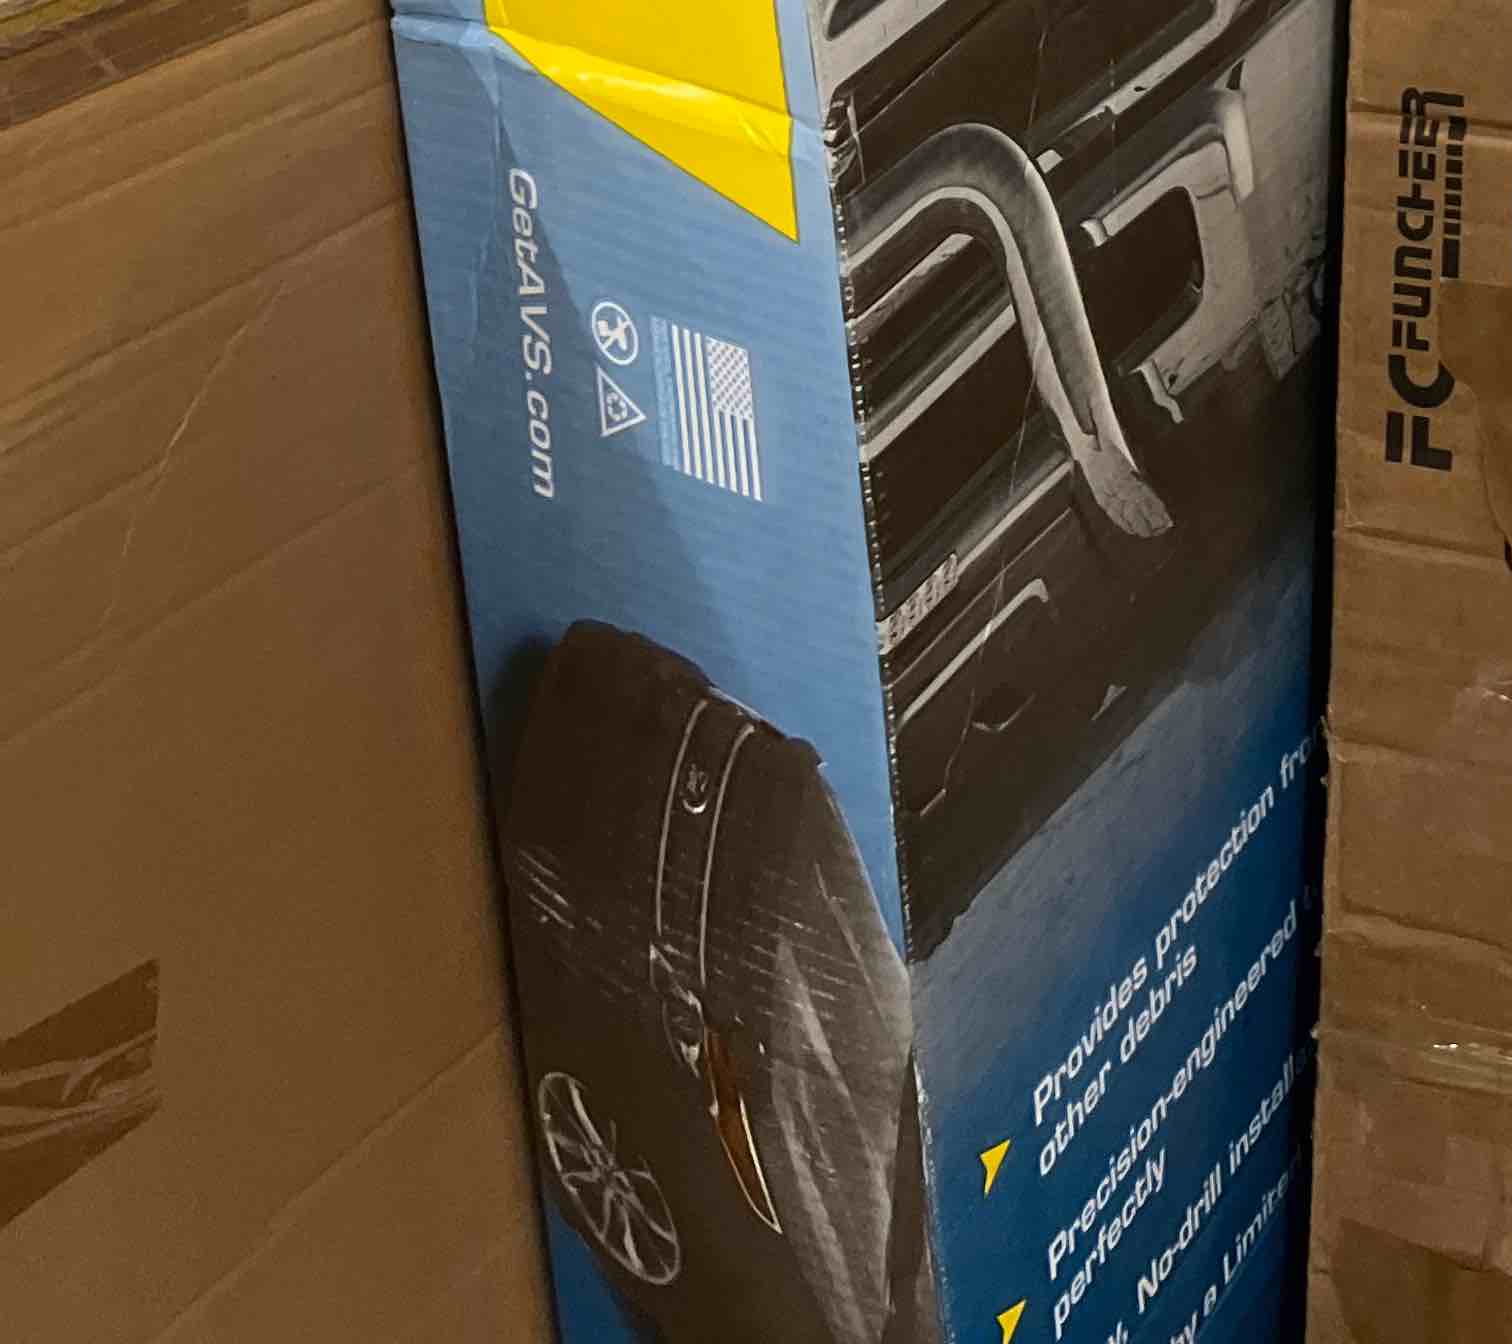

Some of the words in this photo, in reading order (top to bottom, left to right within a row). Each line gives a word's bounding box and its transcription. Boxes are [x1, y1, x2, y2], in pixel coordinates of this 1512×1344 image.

[509, 168, 554, 498] GetAVS.com
[1385, 353, 1456, 472] FC
[1032, 957, 1148, 1124] Provides
[1155, 786, 1275, 964] protection
[1039, 1060, 1112, 1177] other
[1120, 944, 1198, 1064] debris
[1047, 901, 1298, 1280] Precision-engineered
[1054, 1147, 1168, 1340] perfectly
[1137, 1162, 1222, 1313] No-drill
[1203, 1284, 1218, 1317] a
